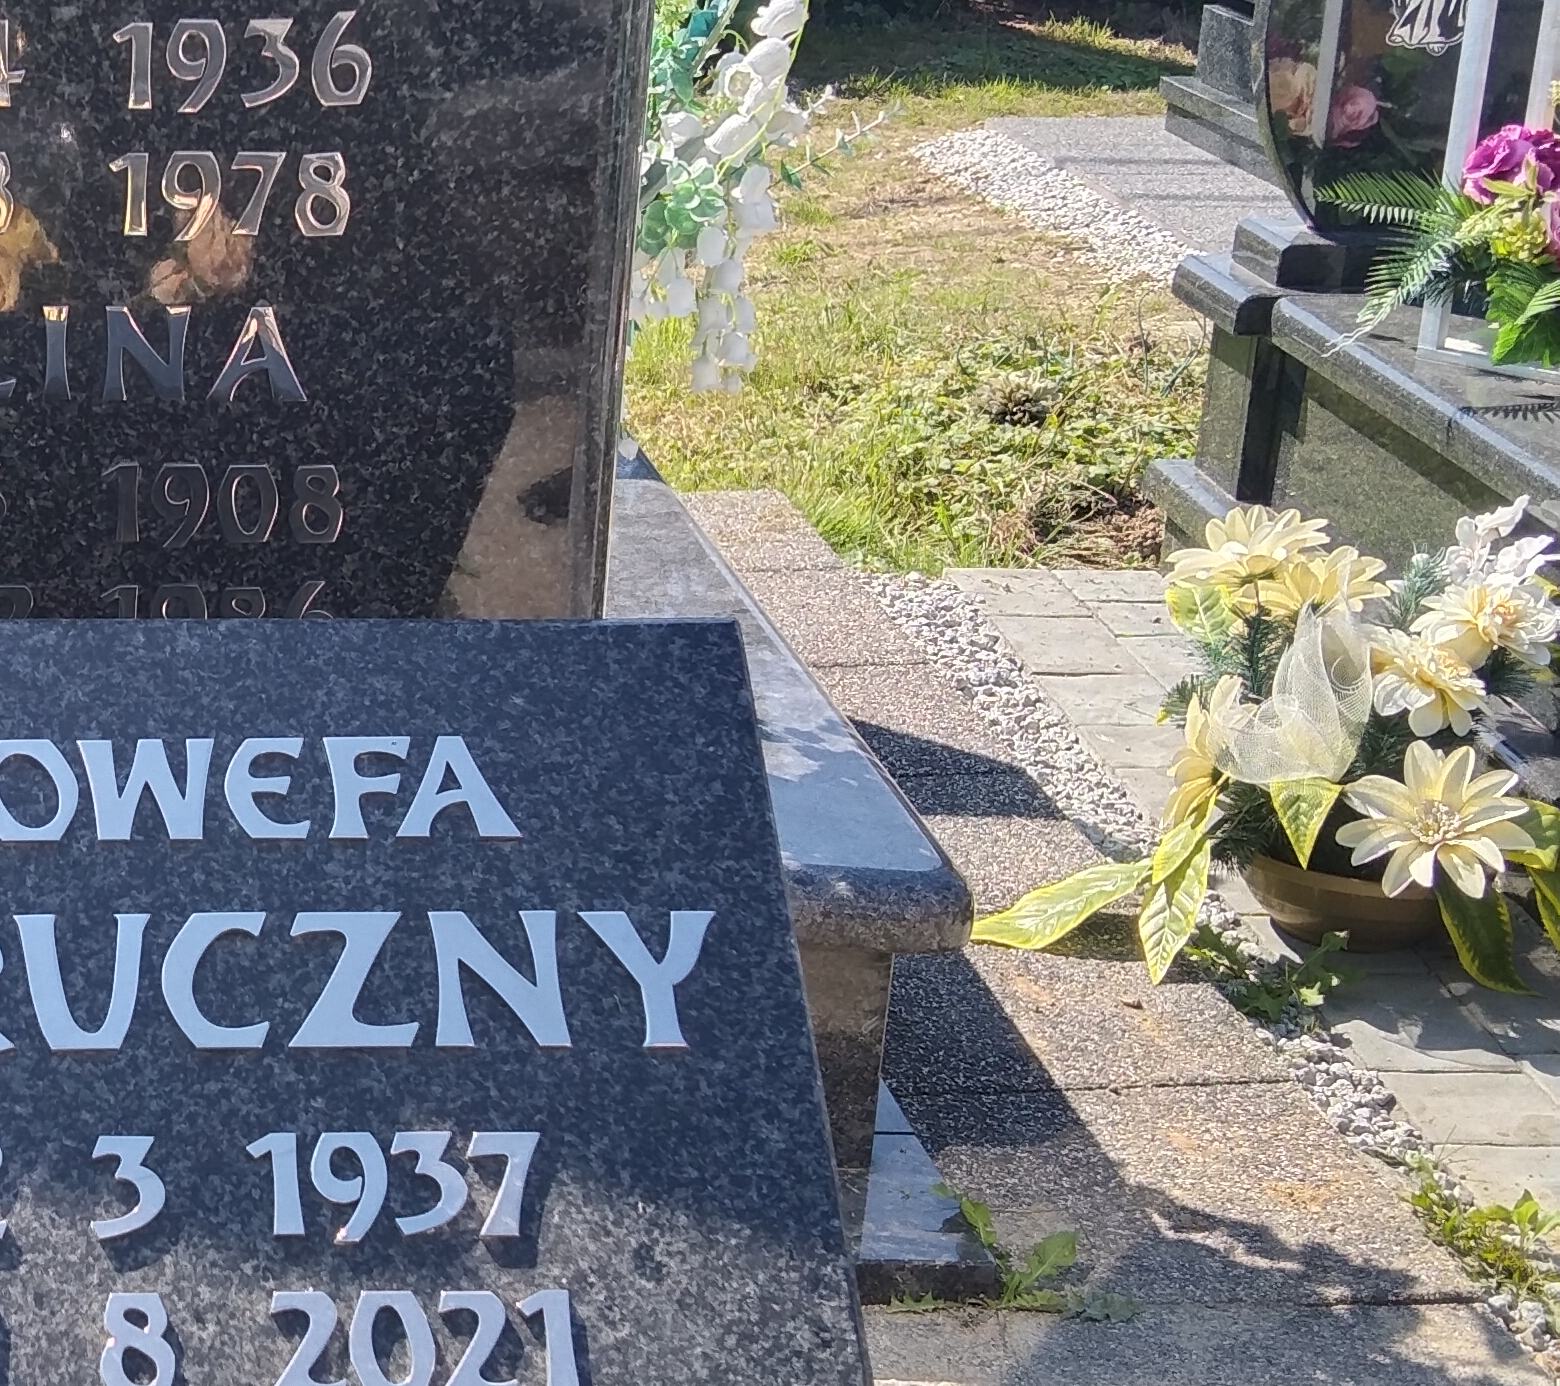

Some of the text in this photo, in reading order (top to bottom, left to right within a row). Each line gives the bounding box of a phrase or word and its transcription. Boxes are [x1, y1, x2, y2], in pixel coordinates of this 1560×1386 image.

[112, 10, 373, 113] 1936
[109, 151, 352, 241] 1978
[101, 462, 344, 549] 1908
[90, 1136, 165, 1240] 3
[246, 1131, 541, 1243] 1937
